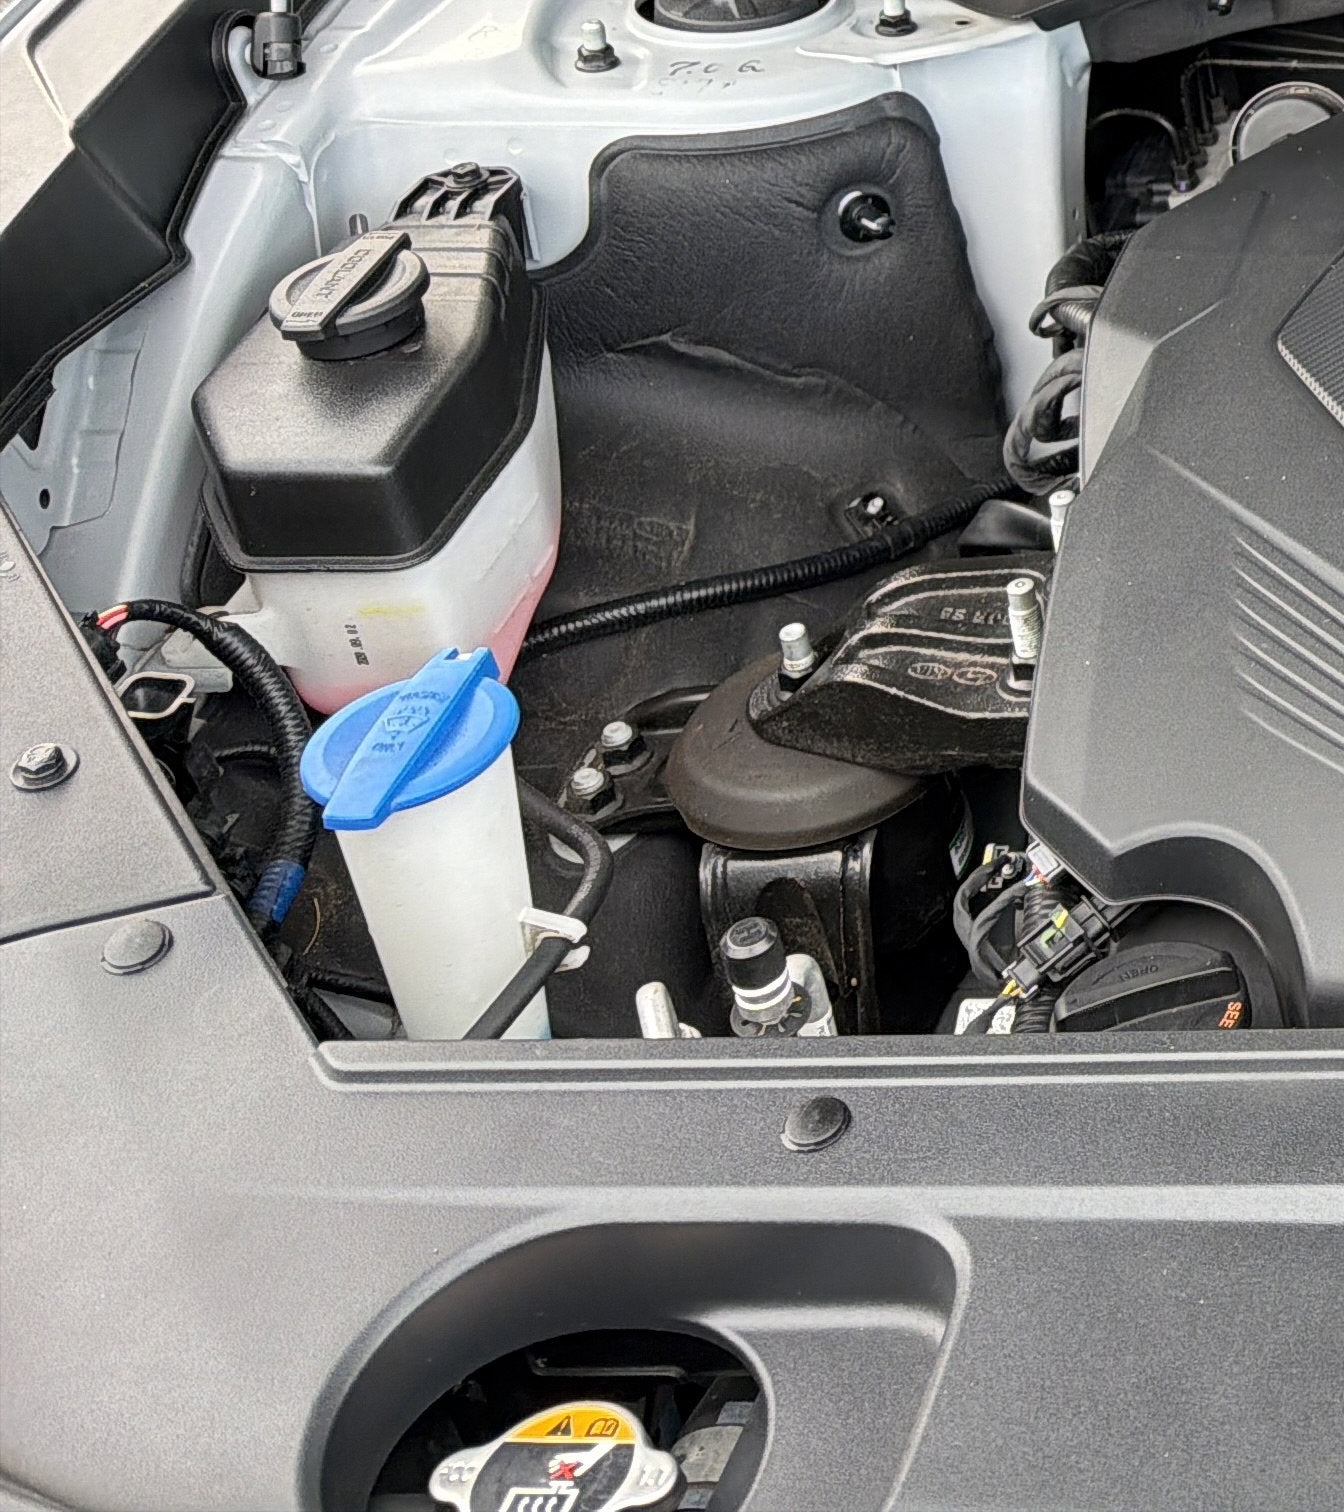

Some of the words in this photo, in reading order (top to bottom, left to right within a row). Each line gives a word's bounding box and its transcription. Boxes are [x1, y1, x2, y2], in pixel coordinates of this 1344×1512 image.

[315, 248, 373, 299] COOLANT
[1119, 963, 1160, 982] OPEN
[1217, 1001, 1243, 1029] SEE
